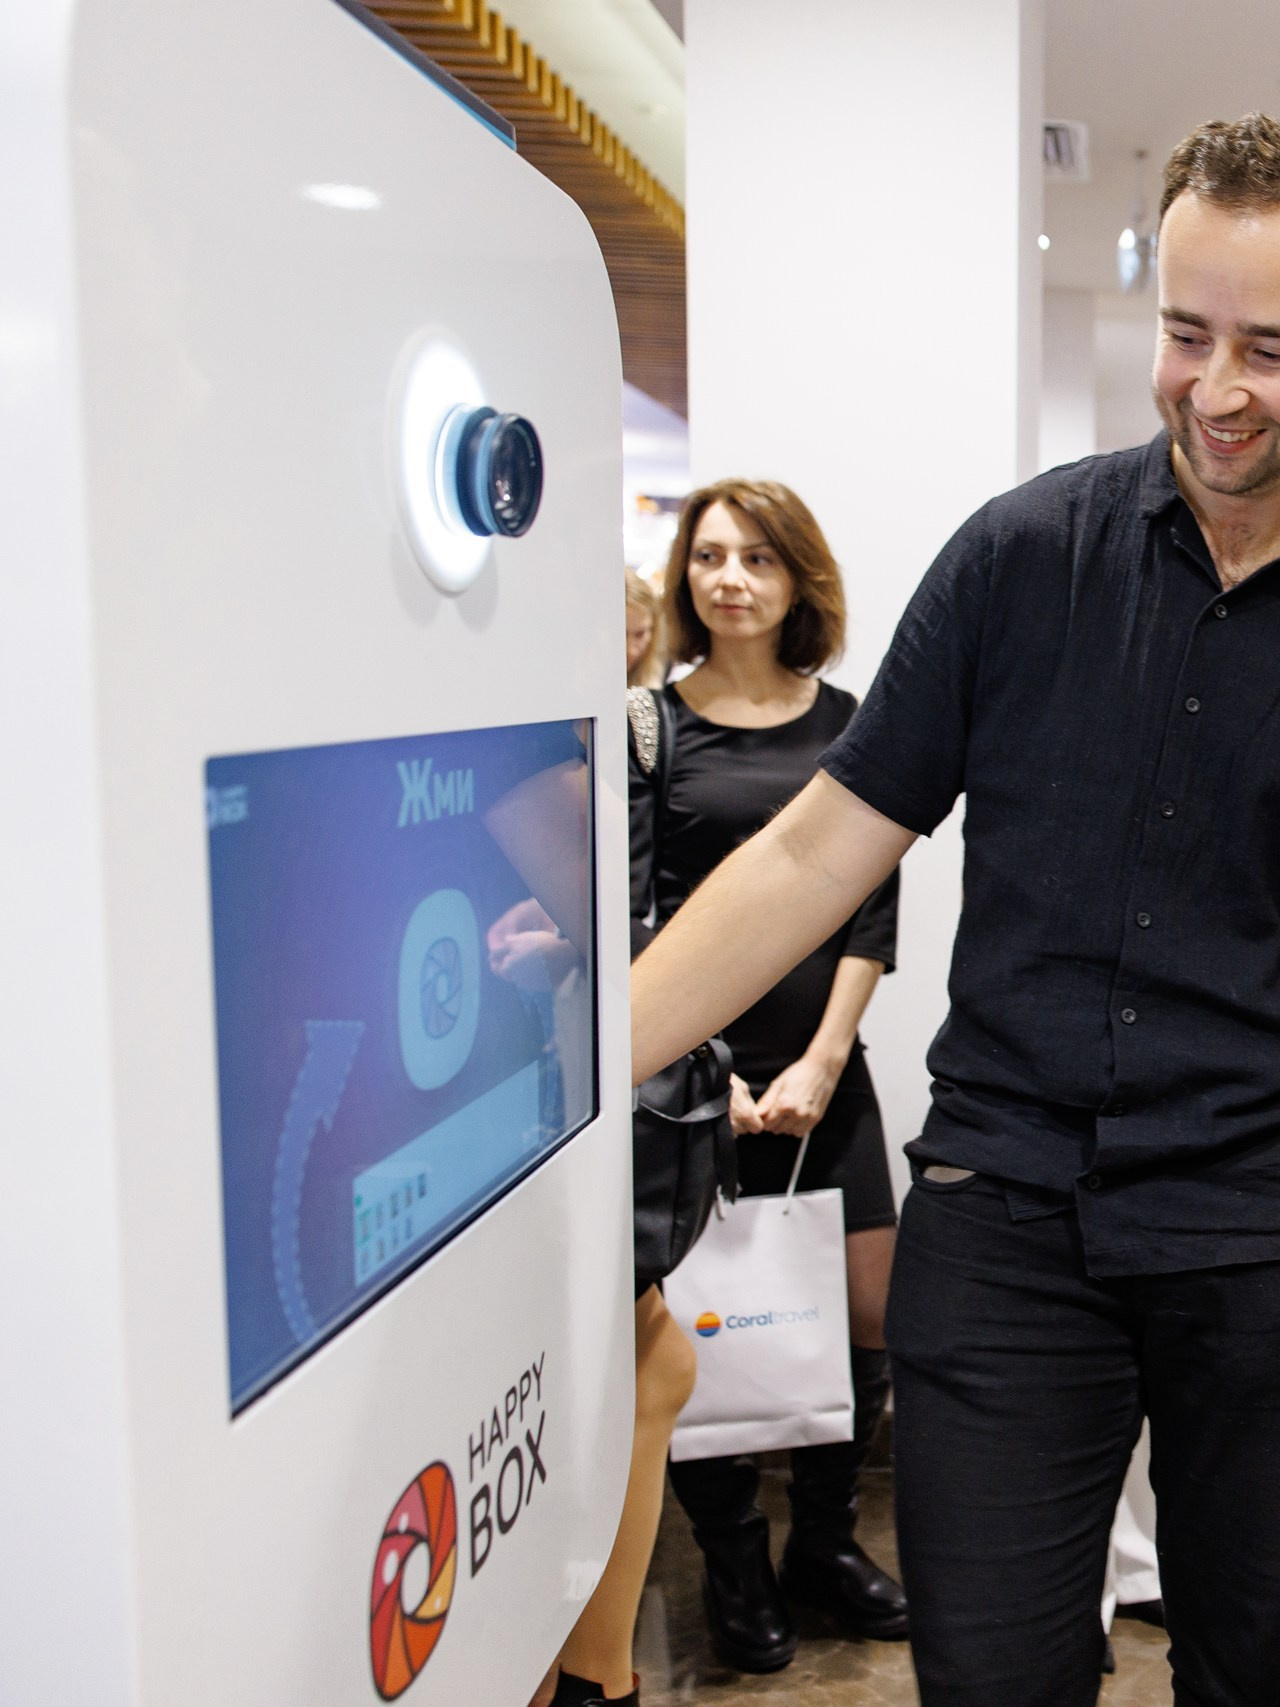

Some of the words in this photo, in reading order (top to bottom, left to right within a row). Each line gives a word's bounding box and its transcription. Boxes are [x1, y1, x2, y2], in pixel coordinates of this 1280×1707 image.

[396, 758, 474, 828] Жми
[469, 1351, 545, 1483] HAPPY
[470, 1410, 547, 1579] BOX
